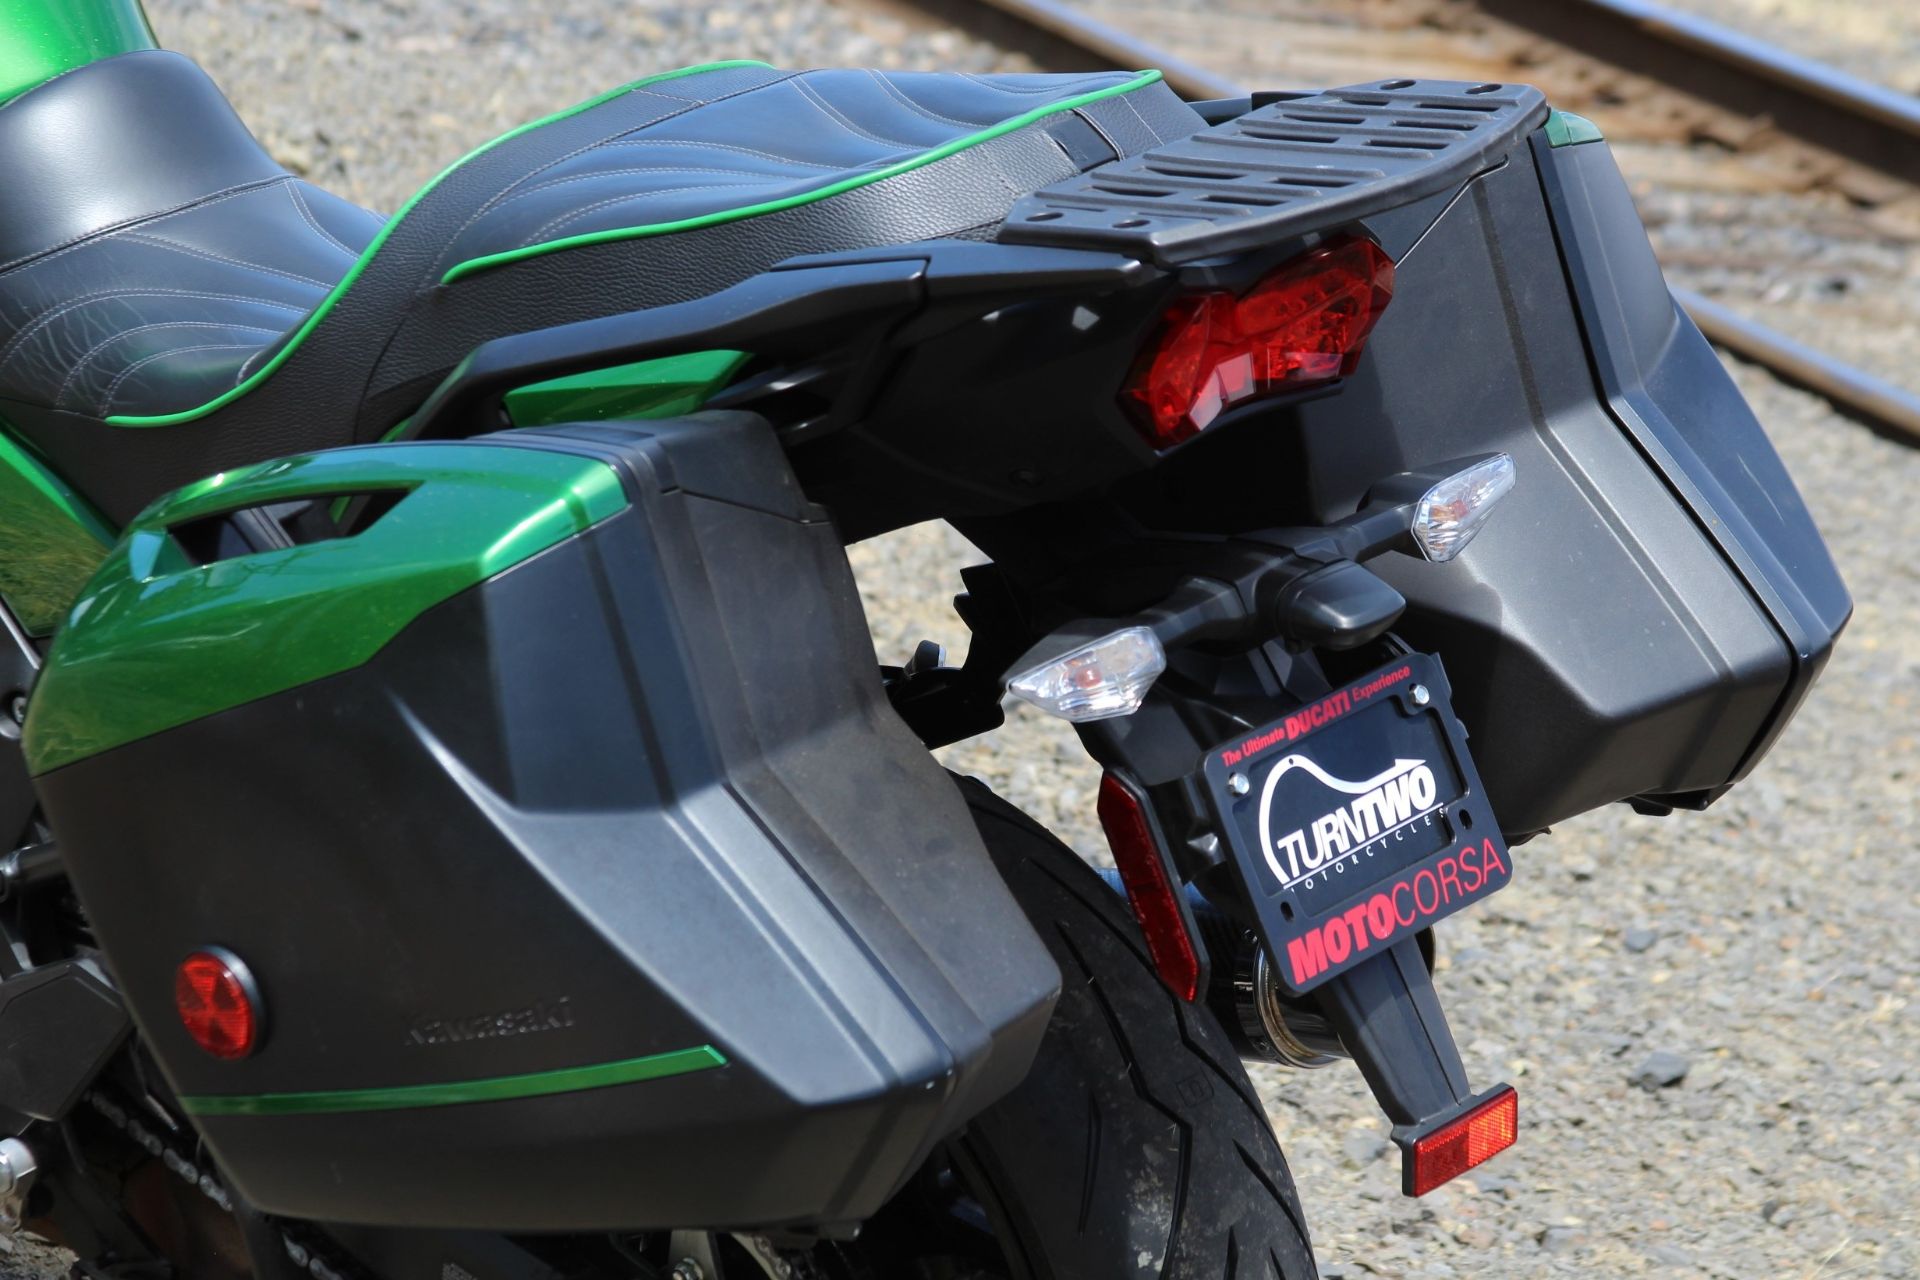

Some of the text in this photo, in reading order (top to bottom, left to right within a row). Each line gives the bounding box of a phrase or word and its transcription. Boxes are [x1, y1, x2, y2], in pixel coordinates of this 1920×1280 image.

[1222, 665, 1411, 767] The Ultimate DUCATI Experience
[1277, 765, 1436, 878] TURNTWO
[1291, 808, 1445, 893] OTORCYCLES
[1287, 838, 1507, 985] MOTOCORSA
[404, 996, 575, 1045] Kawasaki
